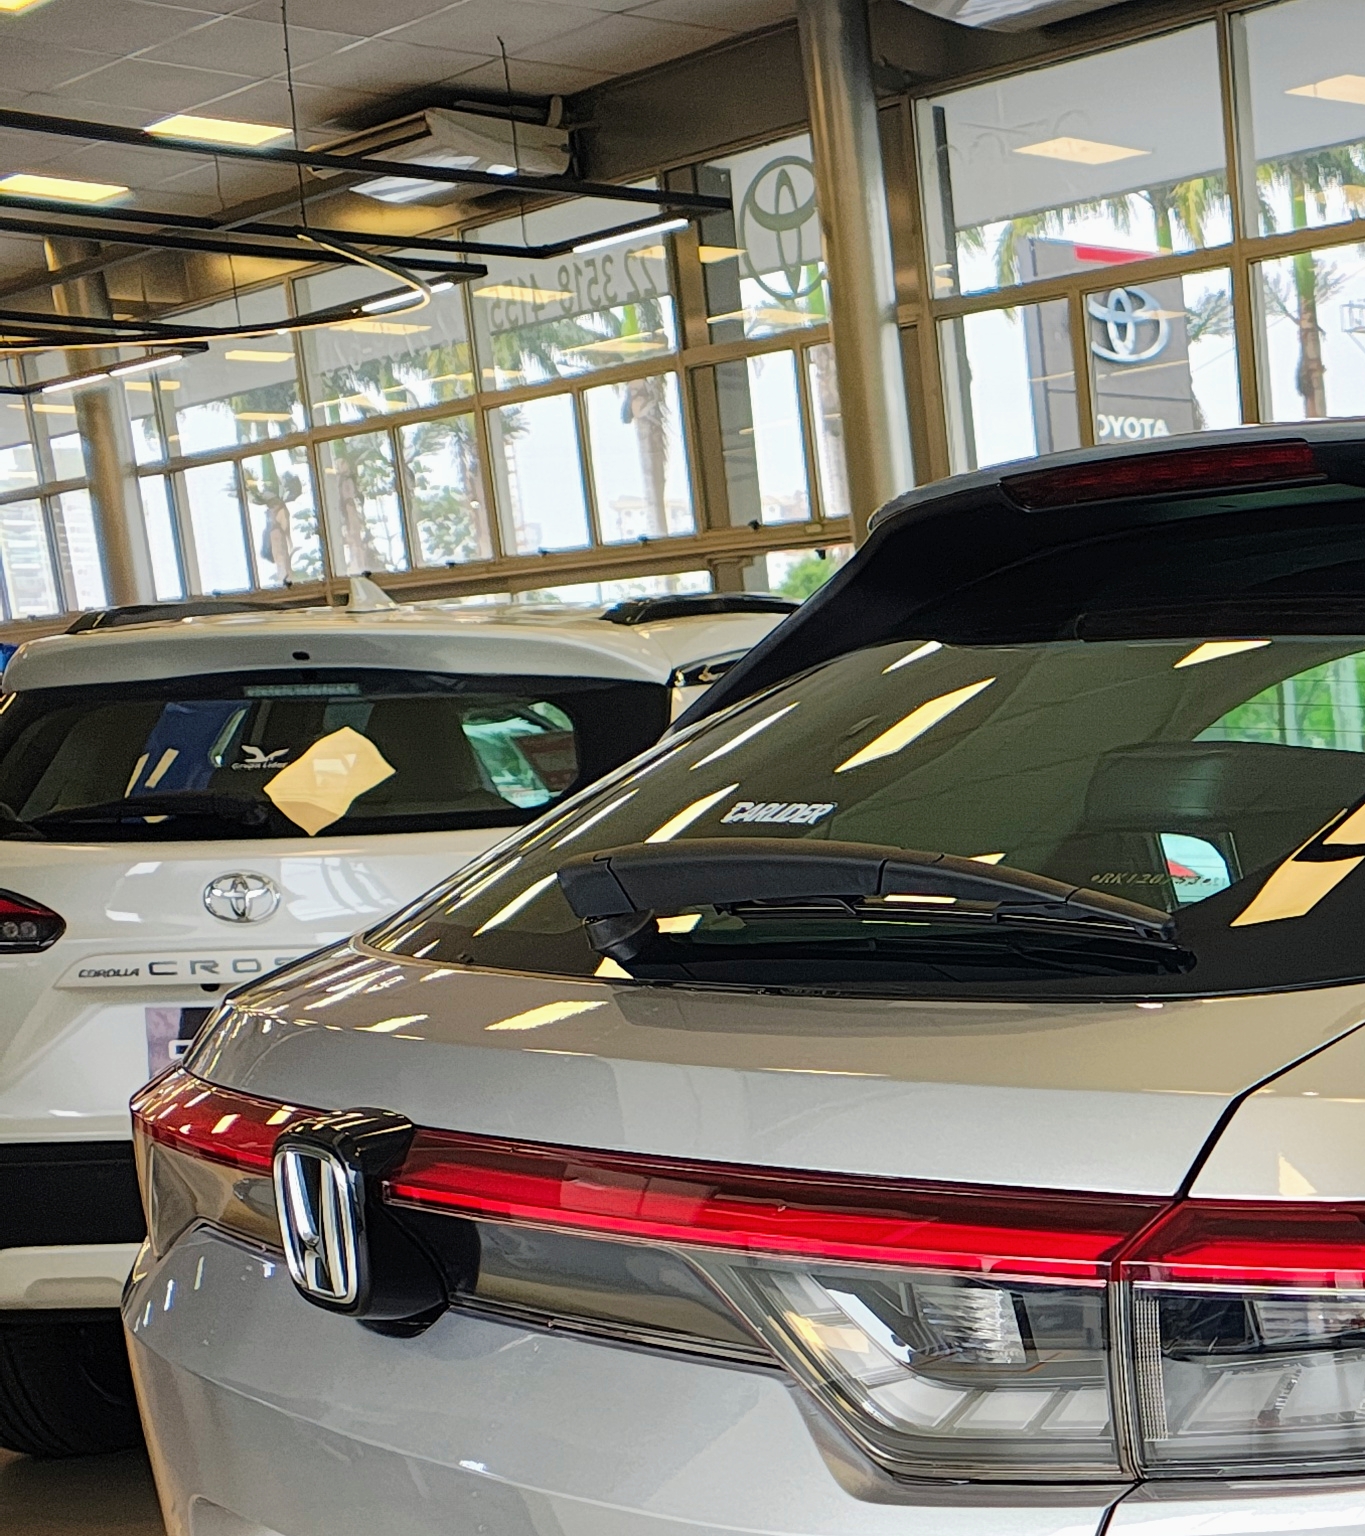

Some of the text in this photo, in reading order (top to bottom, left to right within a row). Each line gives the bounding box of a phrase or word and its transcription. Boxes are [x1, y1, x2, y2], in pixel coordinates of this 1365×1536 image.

[1097, 414, 1169, 438] OYOTA
[720, 802, 835, 825] CARLIDER
[78, 967, 140, 978] COROLLA
